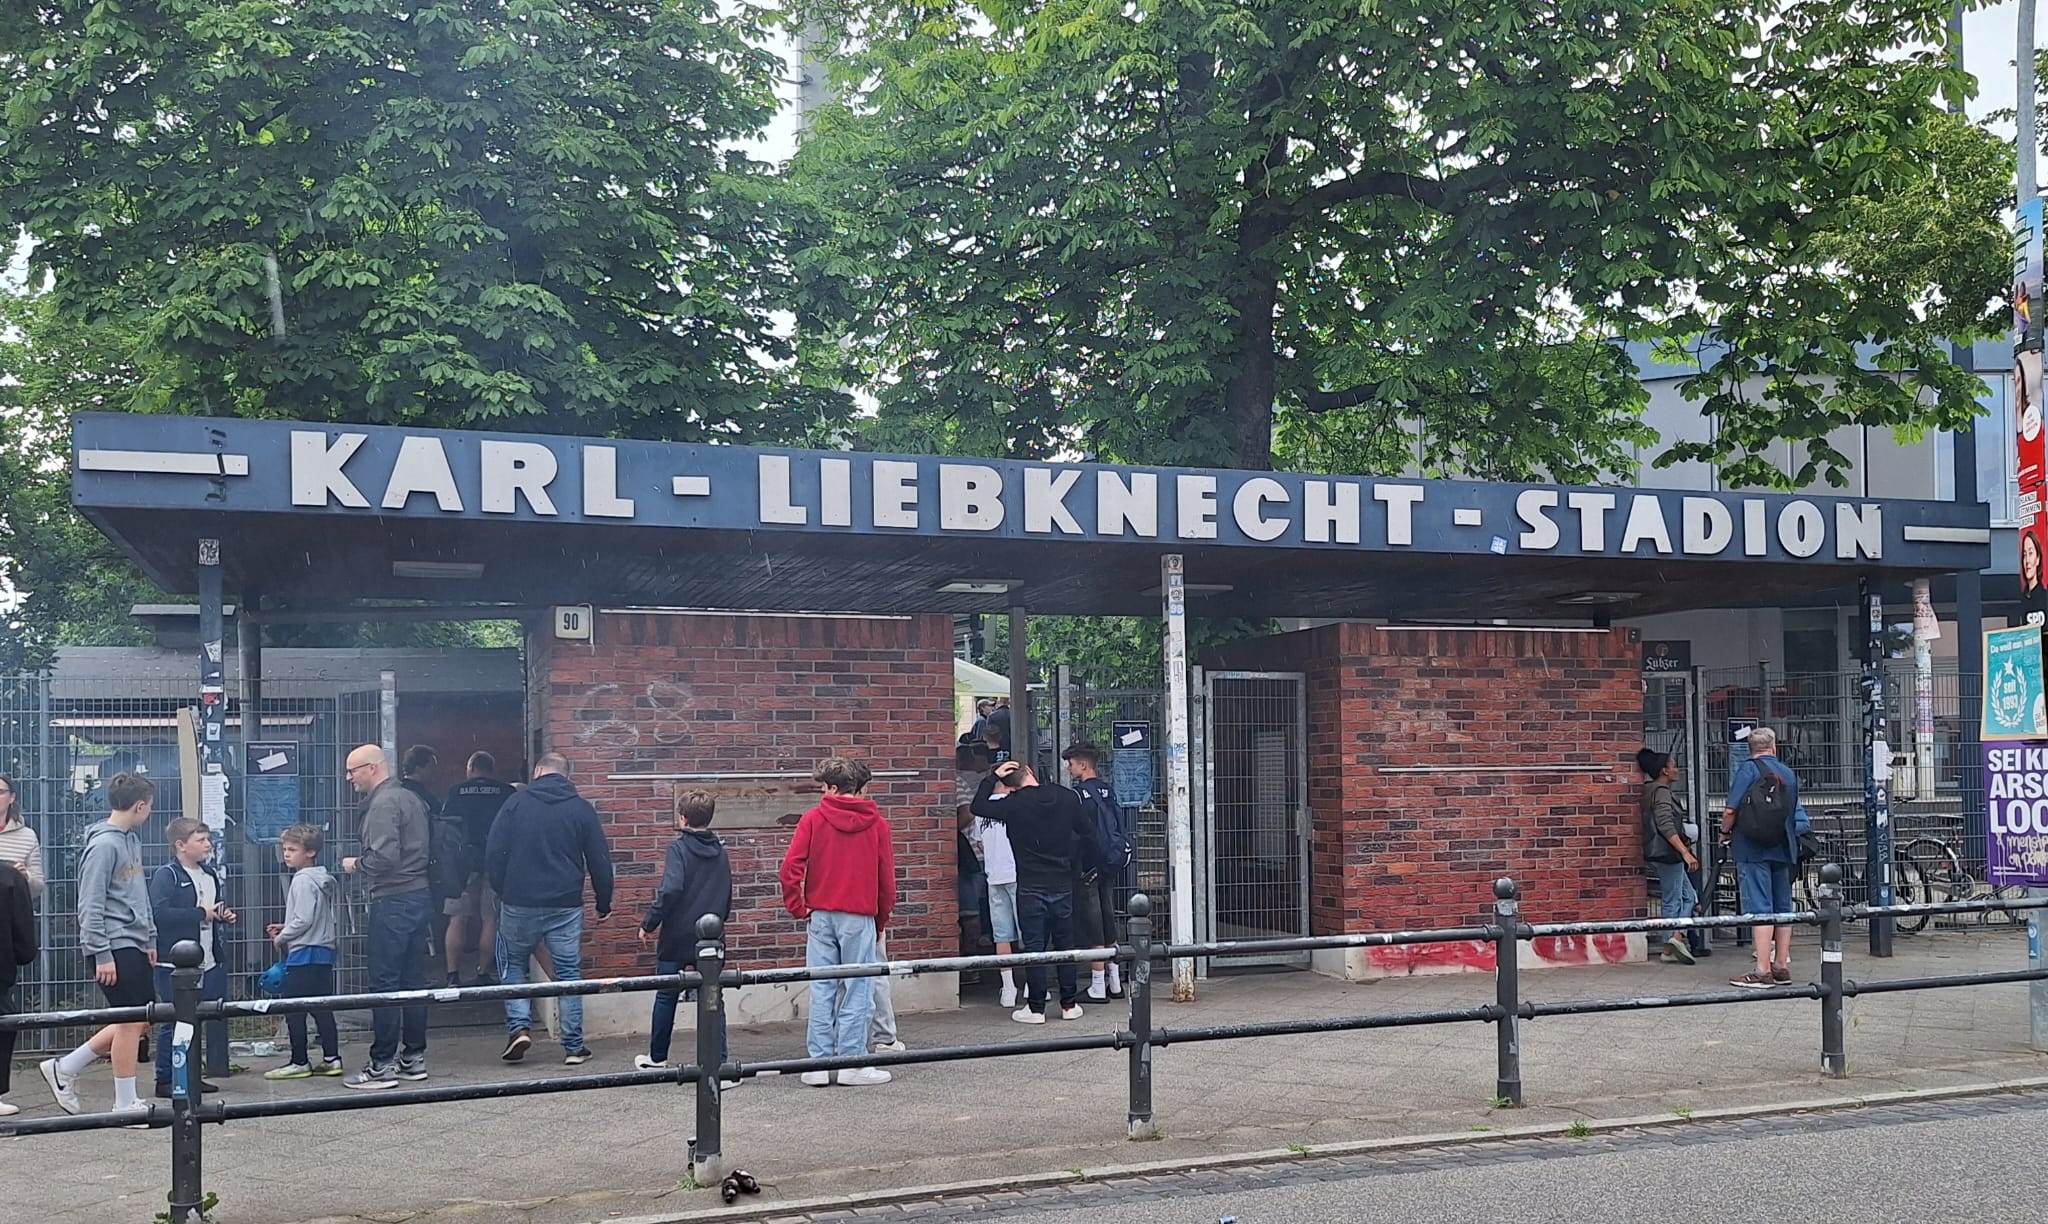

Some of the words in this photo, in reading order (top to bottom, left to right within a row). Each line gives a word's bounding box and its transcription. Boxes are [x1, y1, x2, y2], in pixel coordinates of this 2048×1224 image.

[289, 430, 636, 519] KARL
[758, 454, 1425, 546] LIEBKNECHT
[1516, 488, 1883, 560] STADION
[563, 612, 579, 631] 90
[1988, 748, 2022, 772] SEI
